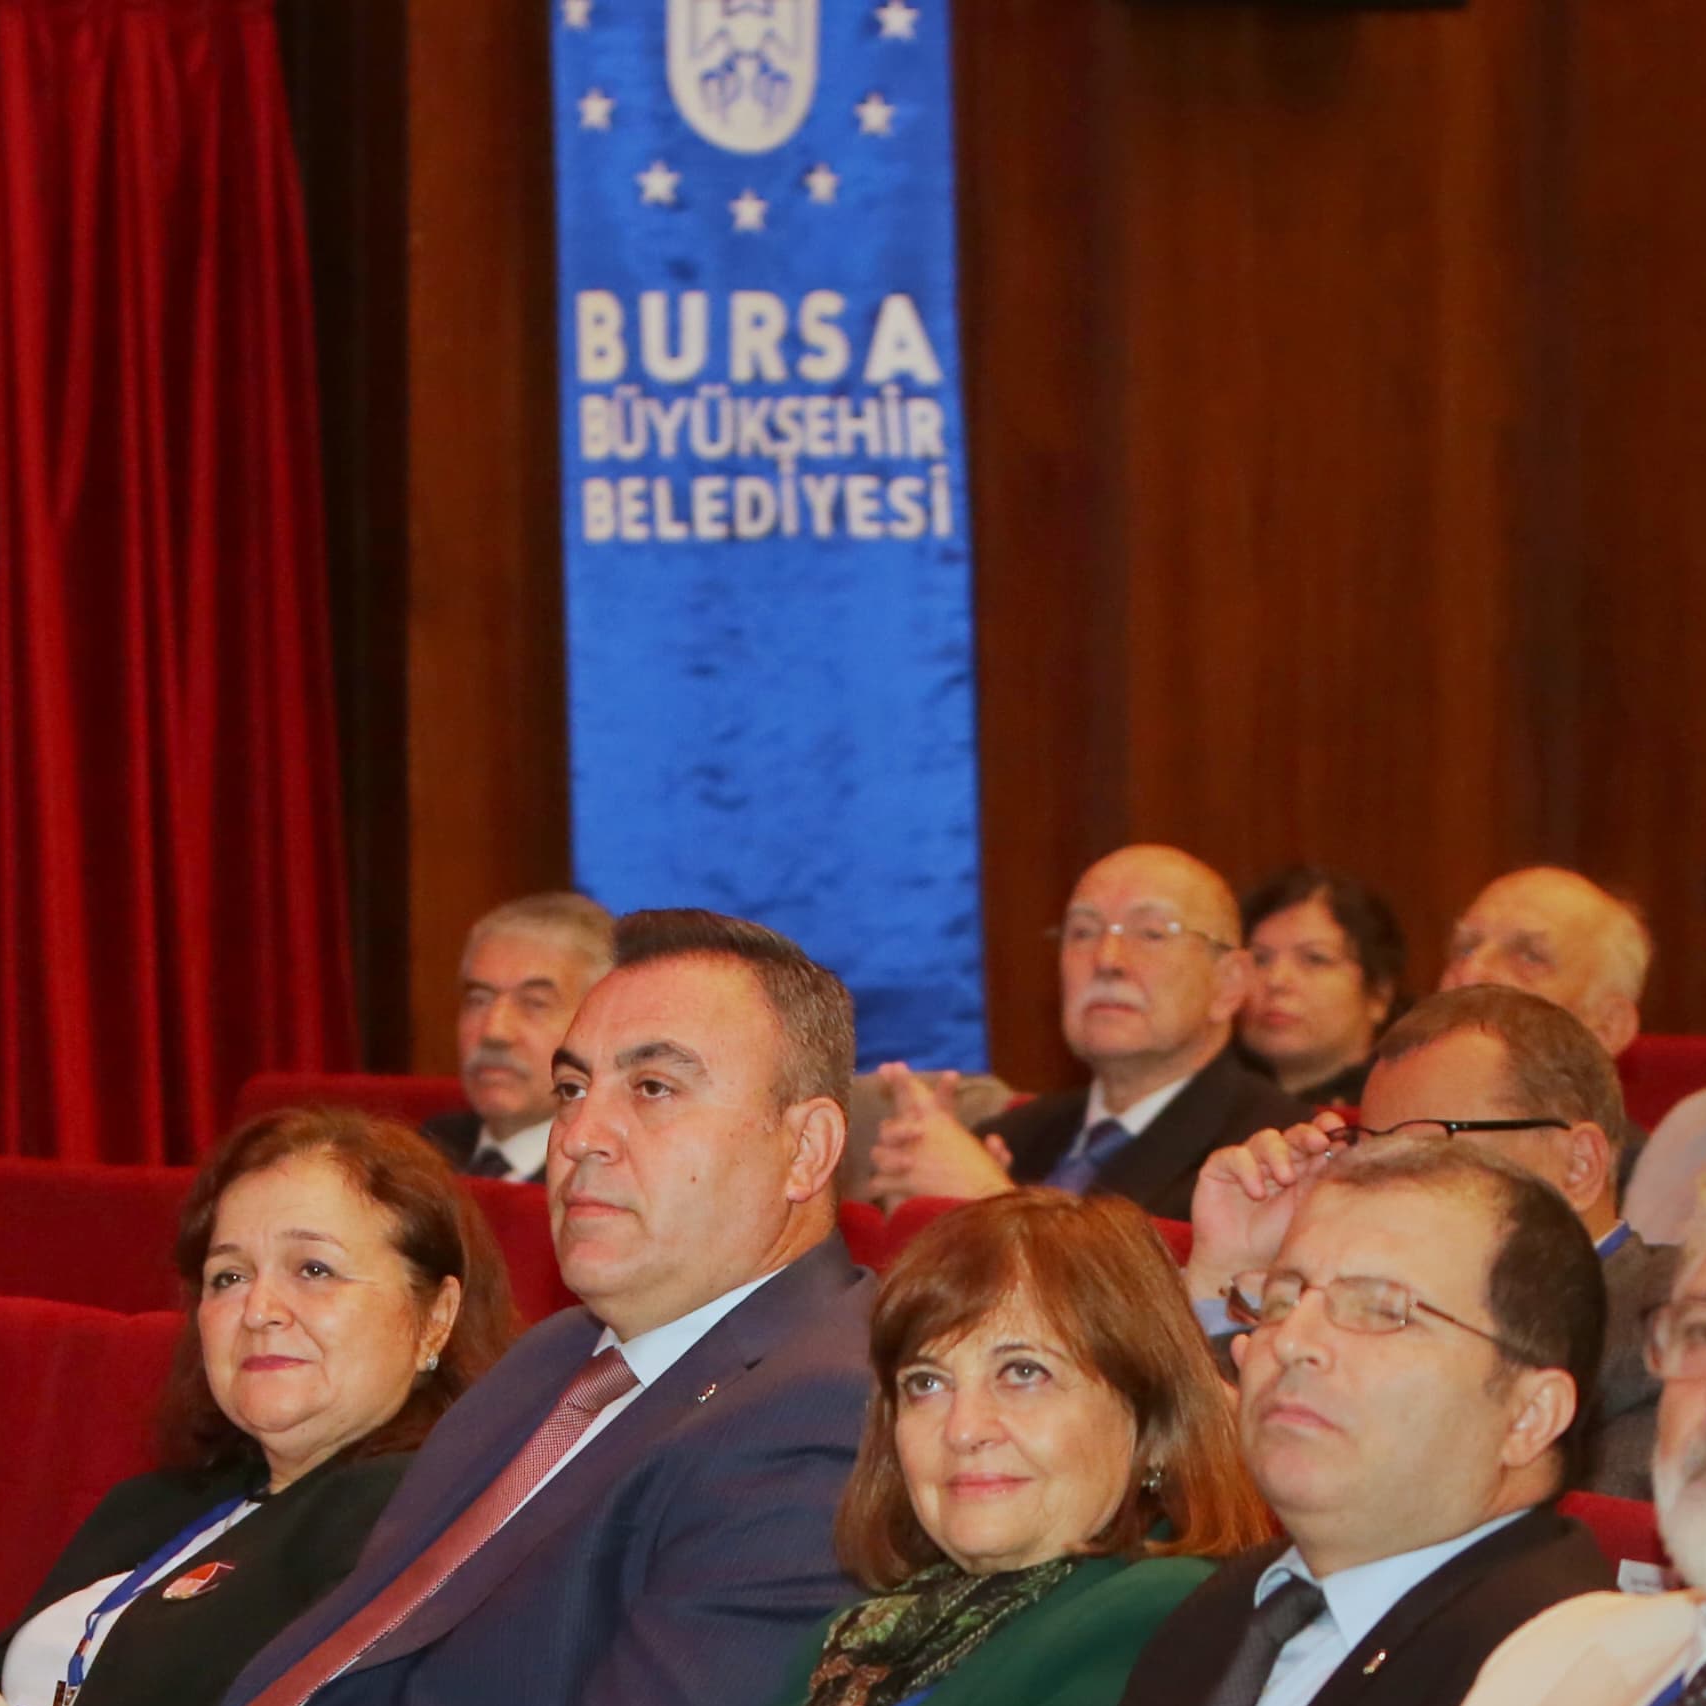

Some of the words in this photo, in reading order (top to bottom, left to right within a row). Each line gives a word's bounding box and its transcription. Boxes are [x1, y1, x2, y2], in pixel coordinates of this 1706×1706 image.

[575, 289, 944, 385] BURSA
[578, 383, 945, 461] BÜYÜKŞEHİR
[581, 460, 954, 543] BELEDİYESİ
